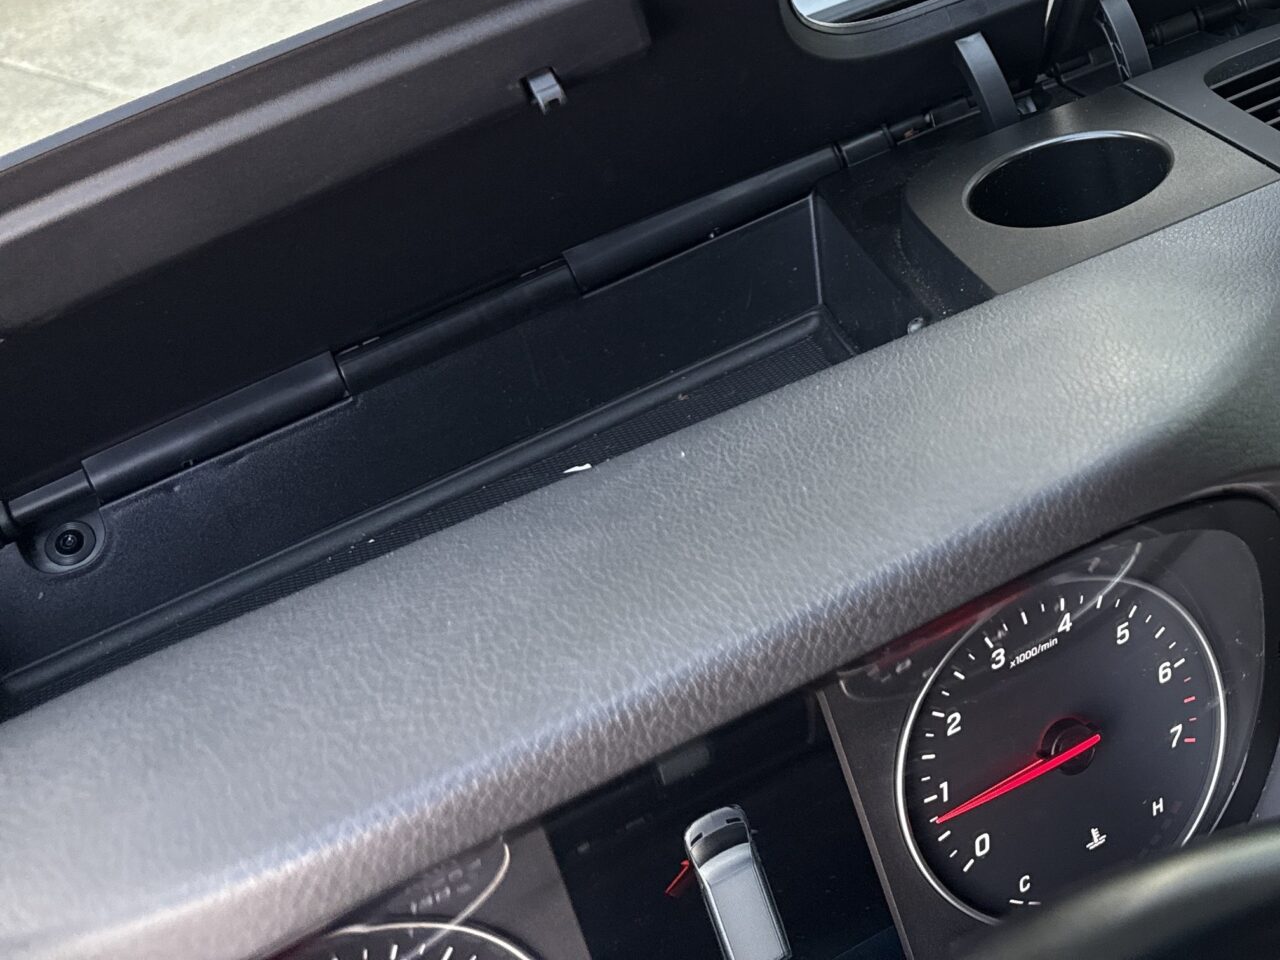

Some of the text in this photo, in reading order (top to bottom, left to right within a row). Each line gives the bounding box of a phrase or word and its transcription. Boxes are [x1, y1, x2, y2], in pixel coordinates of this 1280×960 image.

[1057, 612, 1073, 633] 4
[1116, 621, 1130, 645] 5
[991, 648, 1006, 670] 3
[1010, 637, 1059, 669] x1000/min
[1158, 661, 1172, 684] 6
[946, 712, 962, 736] 2
[1170, 723, 1183, 748] 7
[939, 781, 949, 803] 1
[1152, 797, 1164, 816] H
[974, 832, 991, 857] 0
[1019, 874, 1031, 893] C
